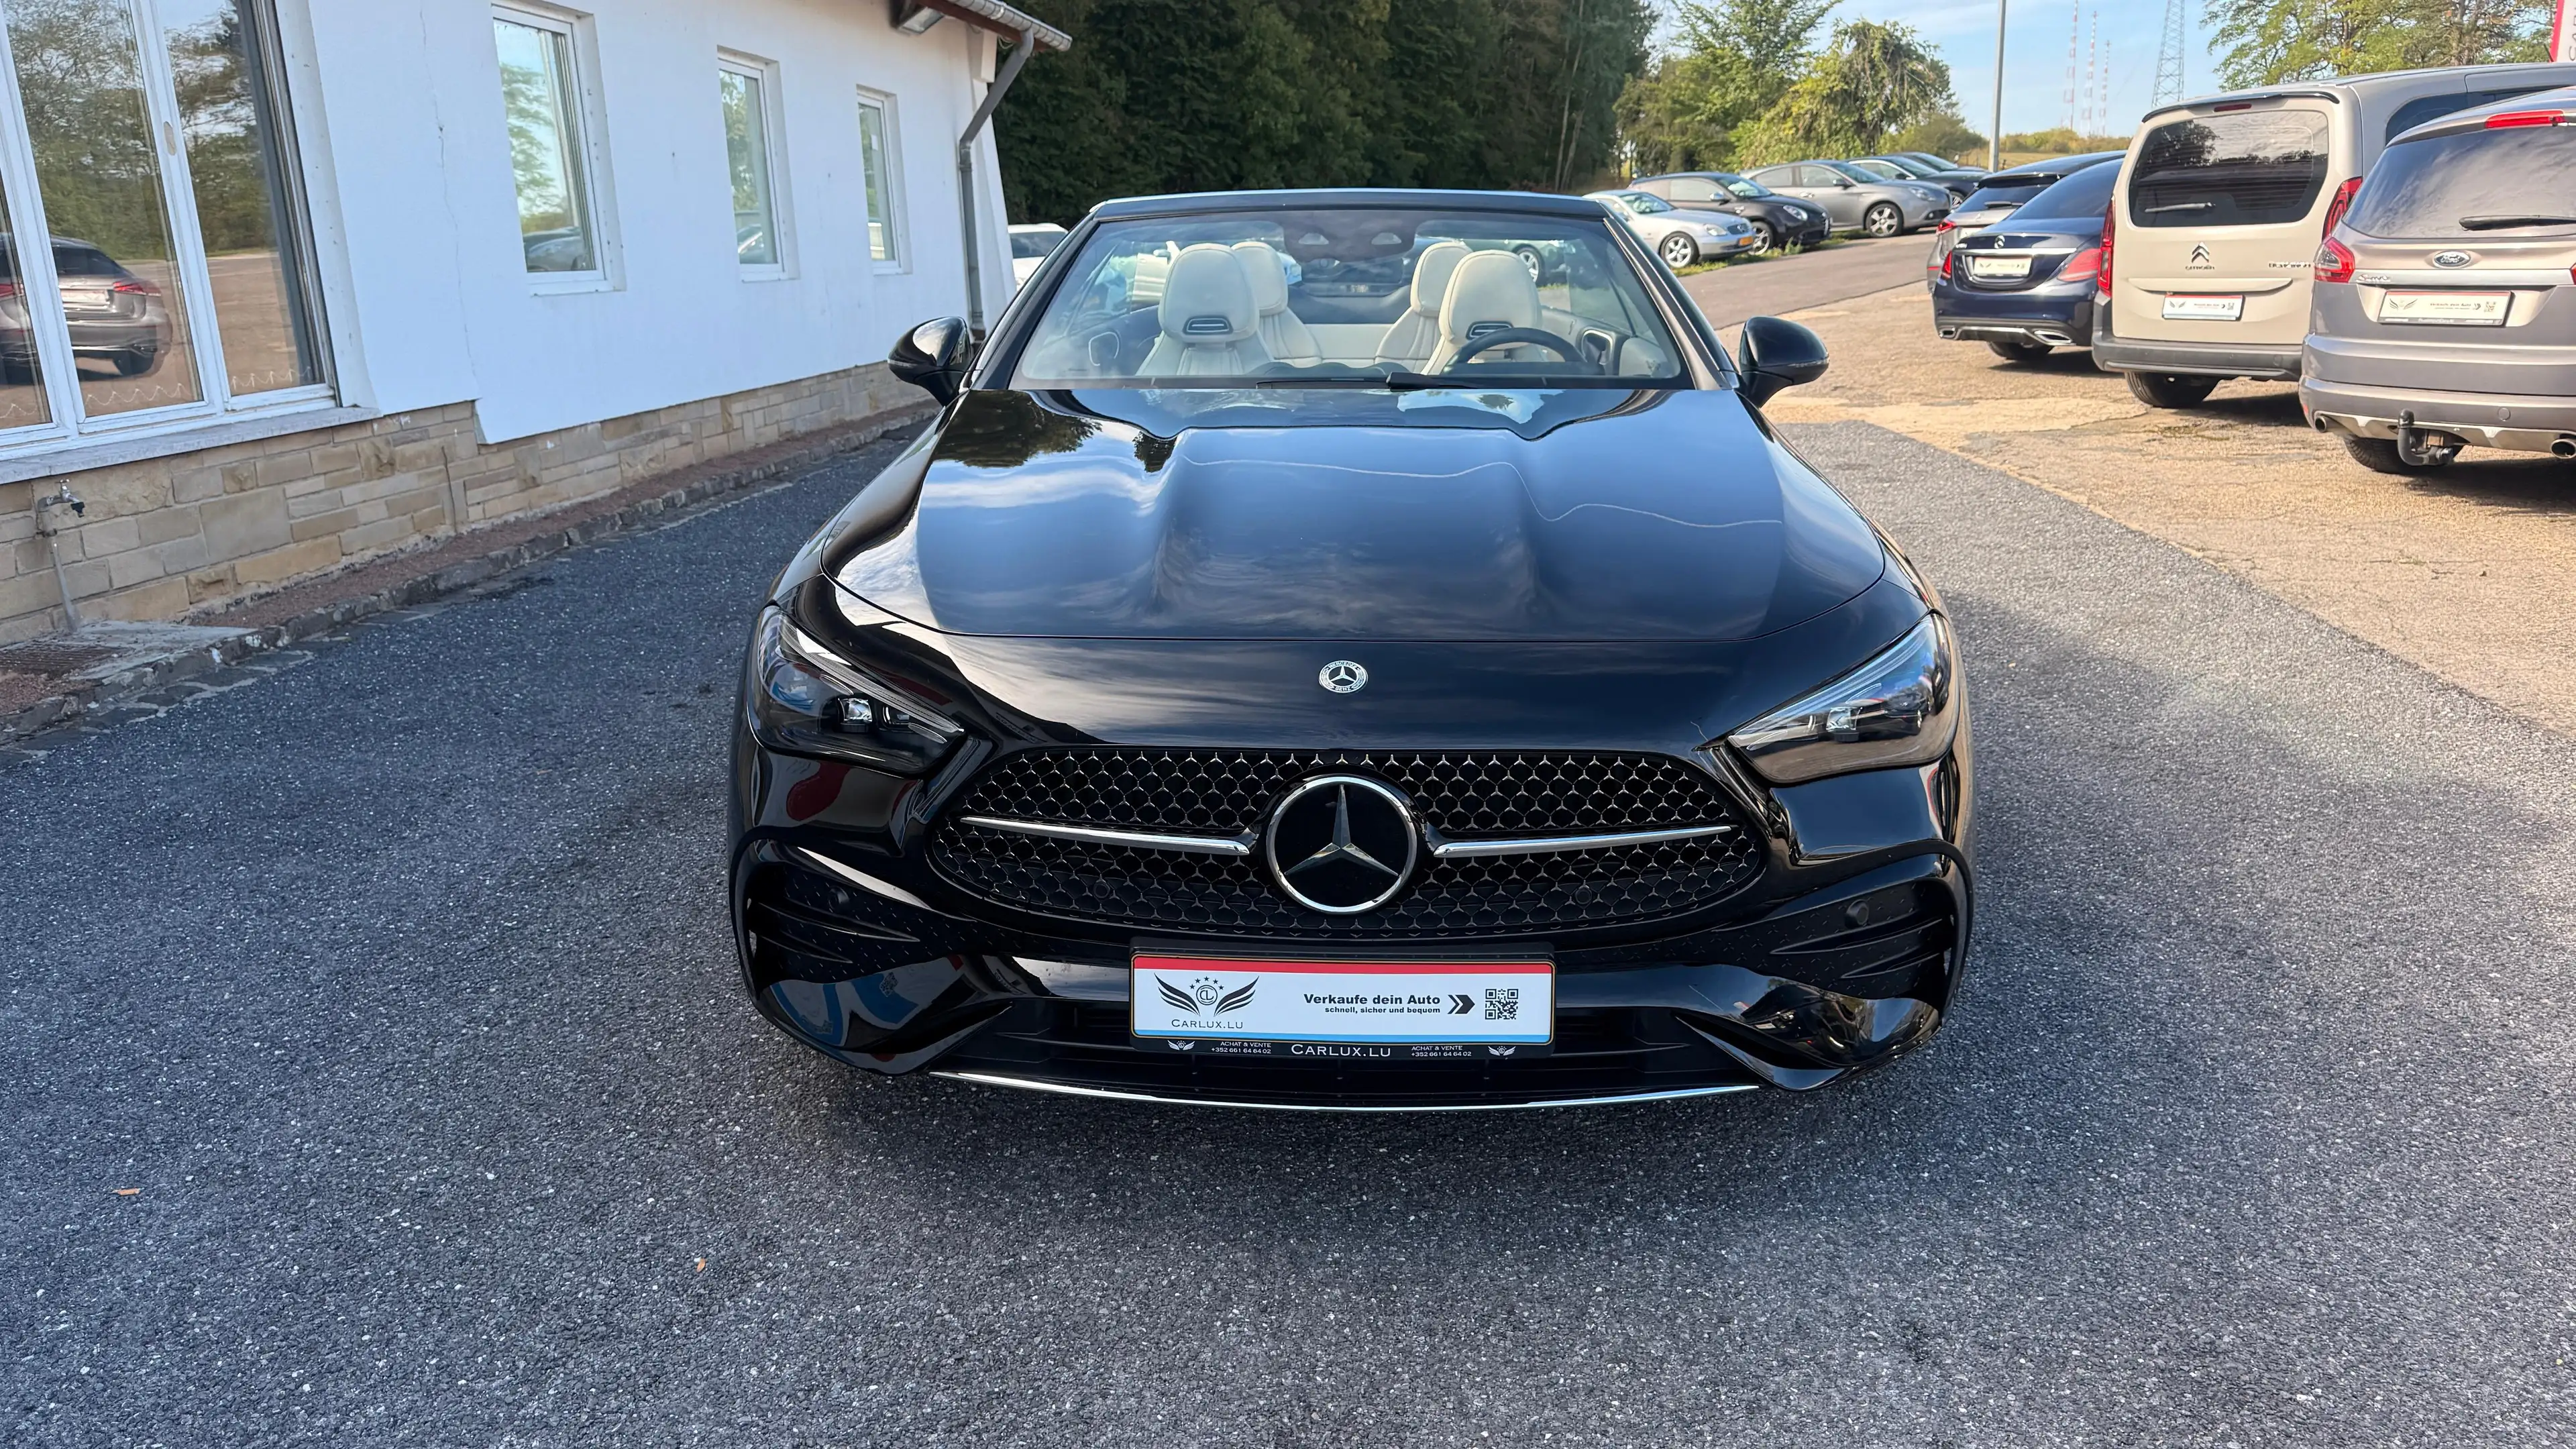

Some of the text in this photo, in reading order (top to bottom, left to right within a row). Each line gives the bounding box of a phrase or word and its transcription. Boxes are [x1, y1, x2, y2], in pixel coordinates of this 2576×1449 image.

[1303, 994, 1441, 1005] Verkaufe dein Auto
[1171, 1019, 1243, 1029] CARLUX.LU
[1291, 1044, 1391, 1057] CARLUX.LU
